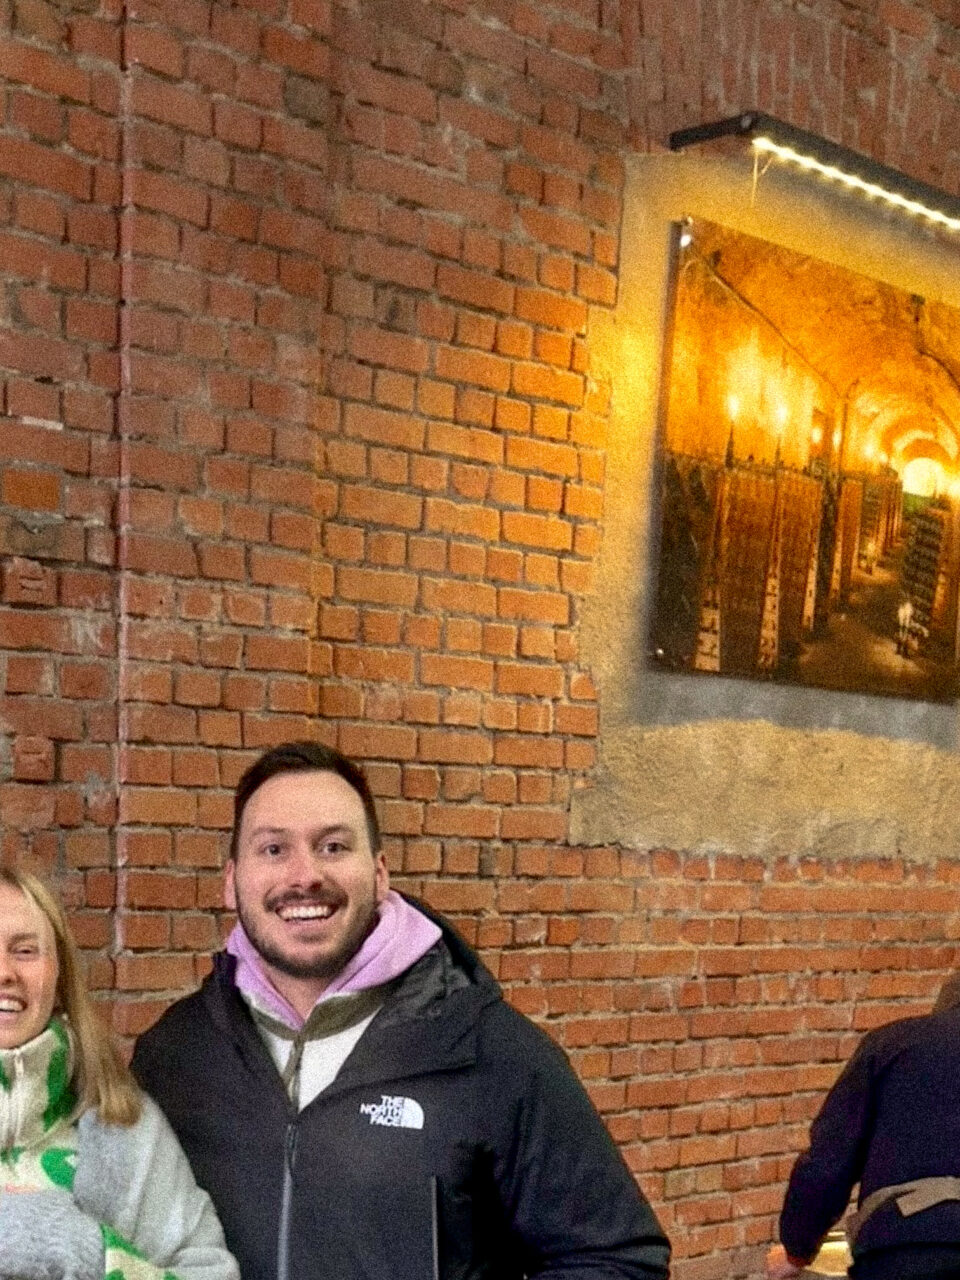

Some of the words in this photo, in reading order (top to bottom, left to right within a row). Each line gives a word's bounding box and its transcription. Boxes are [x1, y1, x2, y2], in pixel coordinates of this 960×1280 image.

[381, 1095, 404, 1106] THE
[360, 1103, 402, 1117] NORTH
[370, 1115, 403, 1127] FACE
